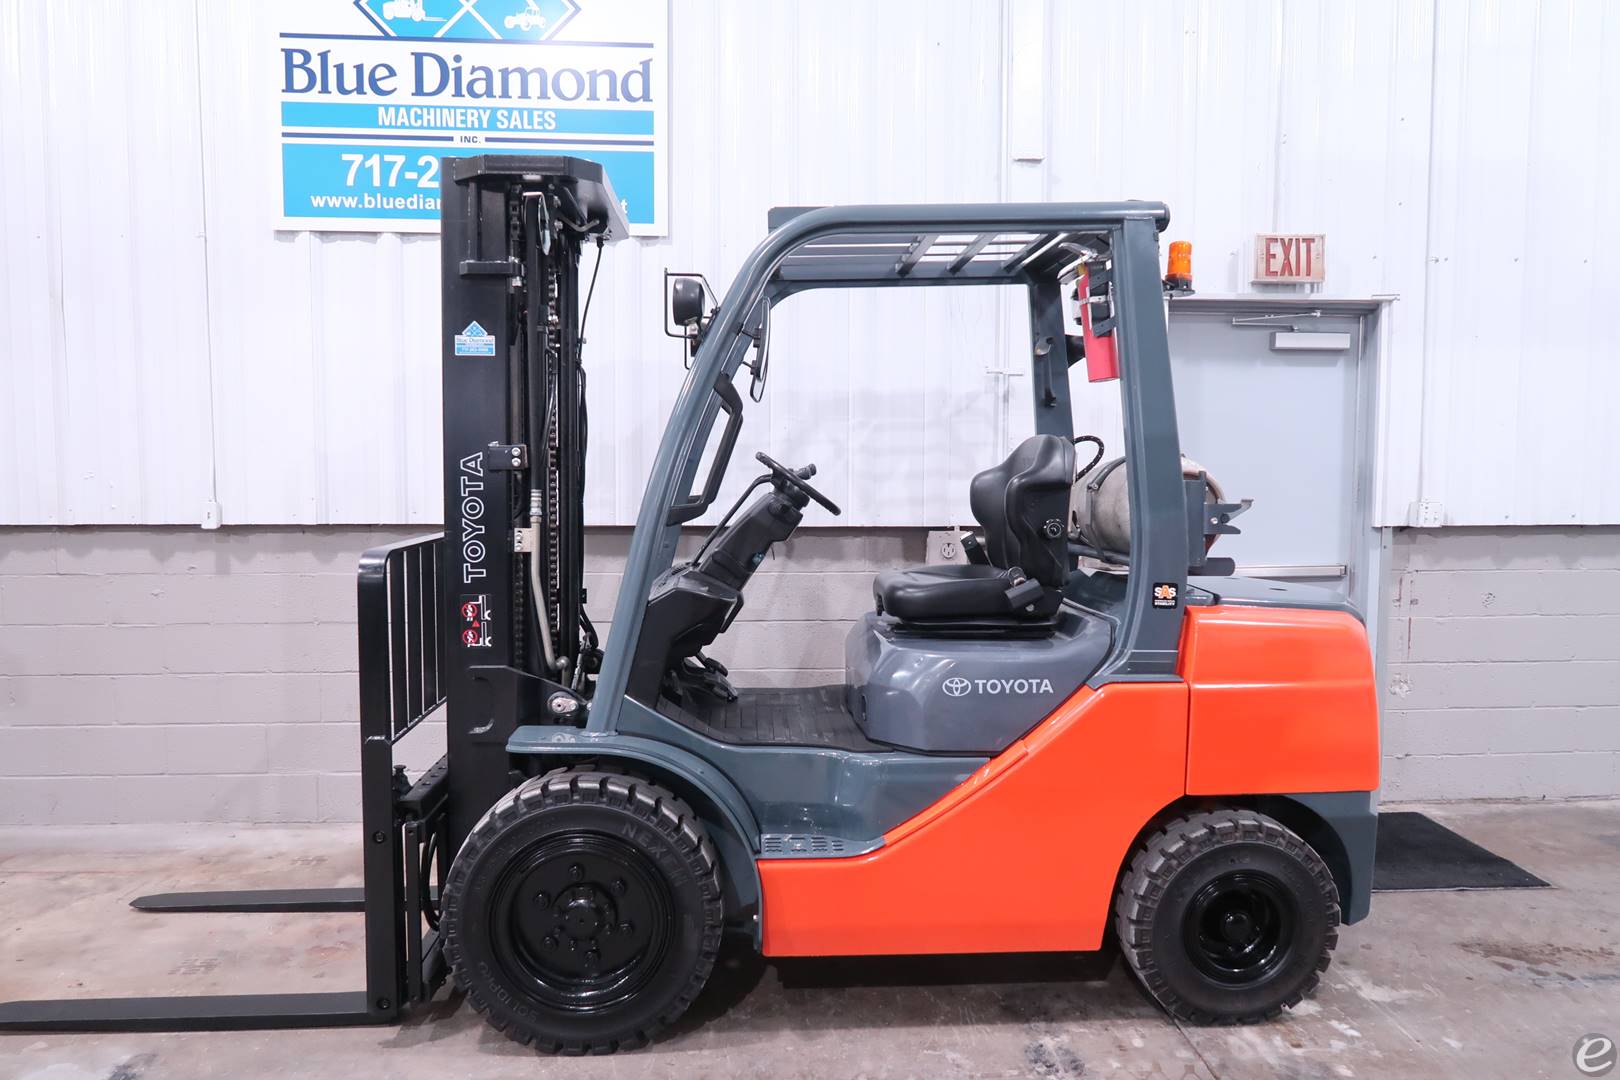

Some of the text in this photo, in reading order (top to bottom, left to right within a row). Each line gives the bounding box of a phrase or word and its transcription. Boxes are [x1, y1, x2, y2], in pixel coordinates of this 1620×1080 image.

[281, 48, 653, 102] Blue Diamond
[378, 106, 556, 130] MACHINERY SALES
[460, 136, 481, 144] INC.
[341, 154, 440, 188] 717-2
[1265, 238, 1315, 276] EXIT
[460, 447, 486, 583] TOYOTA
[1154, 585, 1176, 599] SAS
[975, 679, 1053, 694] TOYOTA
